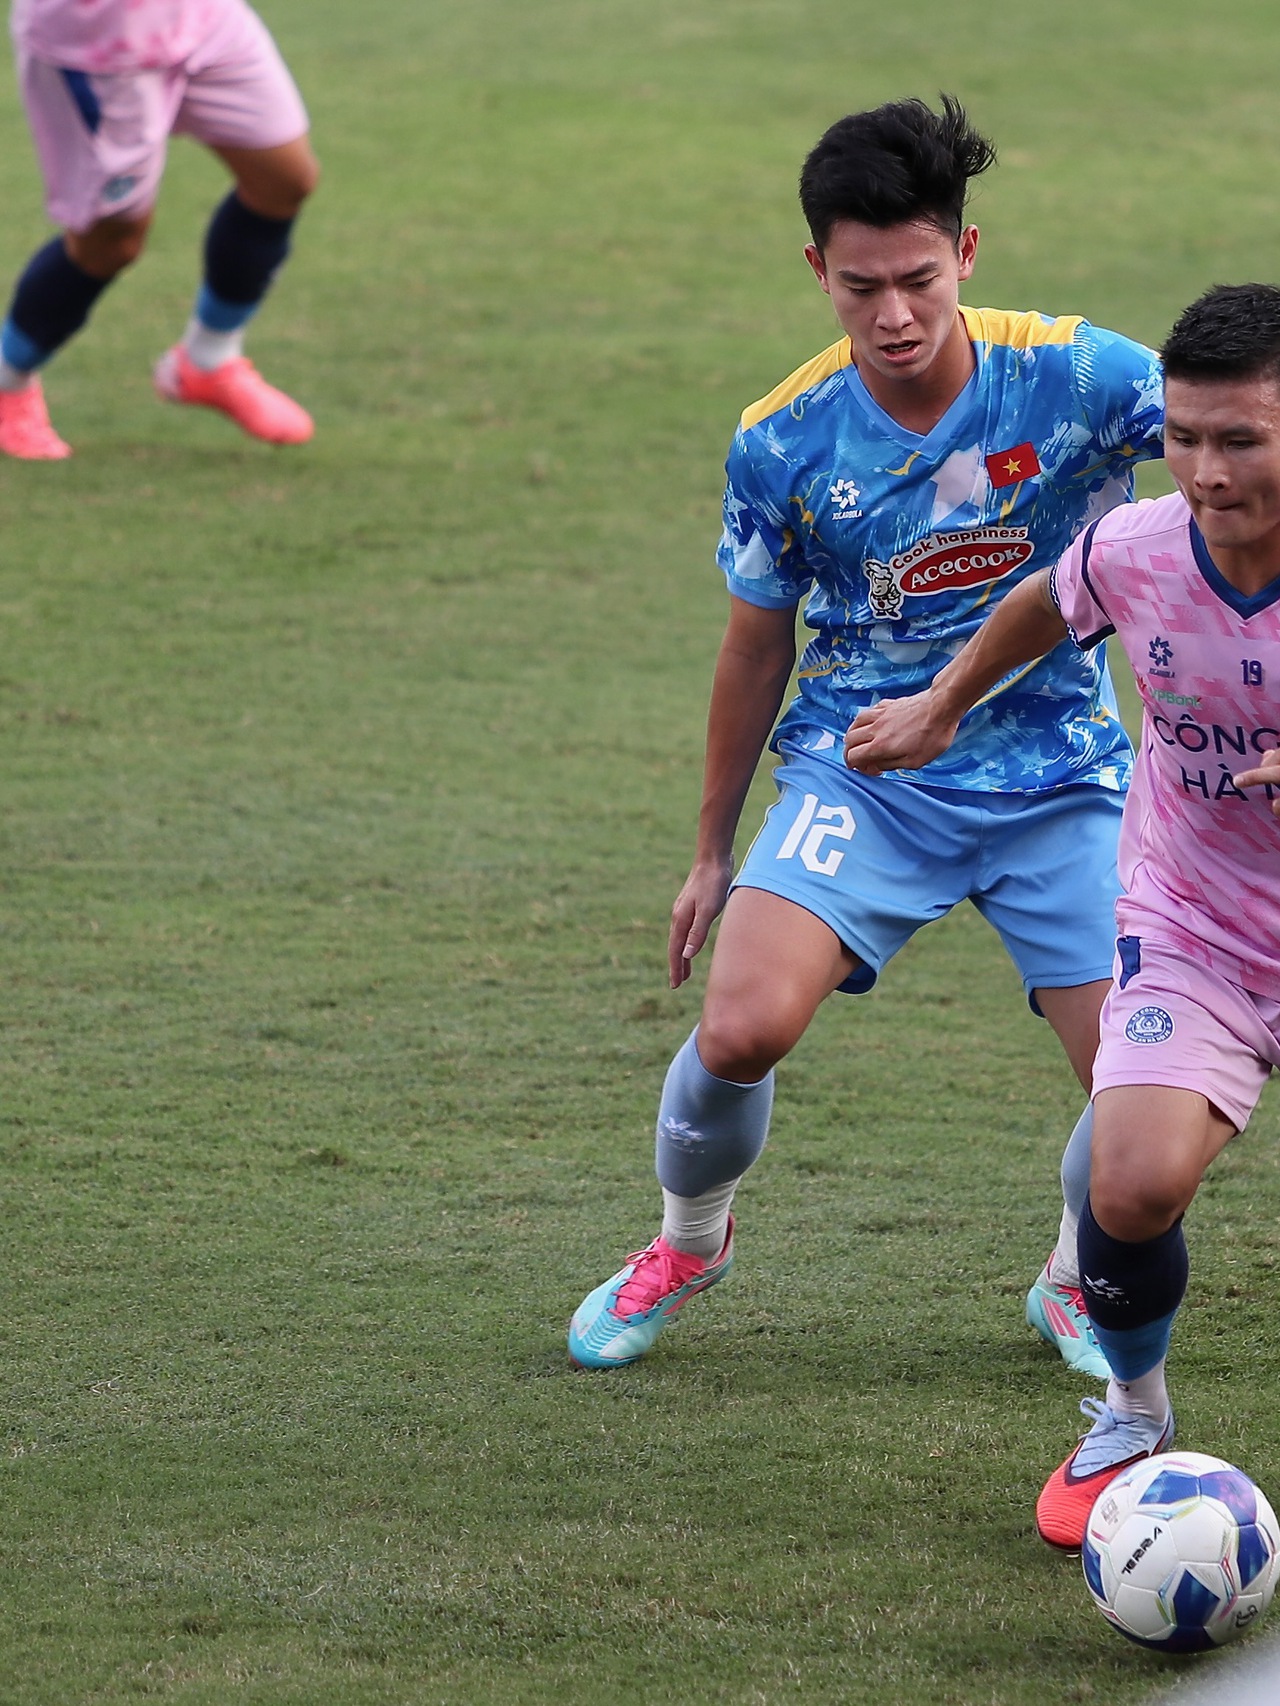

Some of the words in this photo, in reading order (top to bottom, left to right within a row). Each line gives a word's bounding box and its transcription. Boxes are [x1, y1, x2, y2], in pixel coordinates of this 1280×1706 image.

[892, 541, 934, 570] Cook
[936, 527, 1027, 546] happiness
[1240, 658, 1263, 687] 19
[1180, 763, 1249, 801] HÀ
[776, 793, 857, 877] 12
[1121, 1526, 1163, 1575] TERRA
